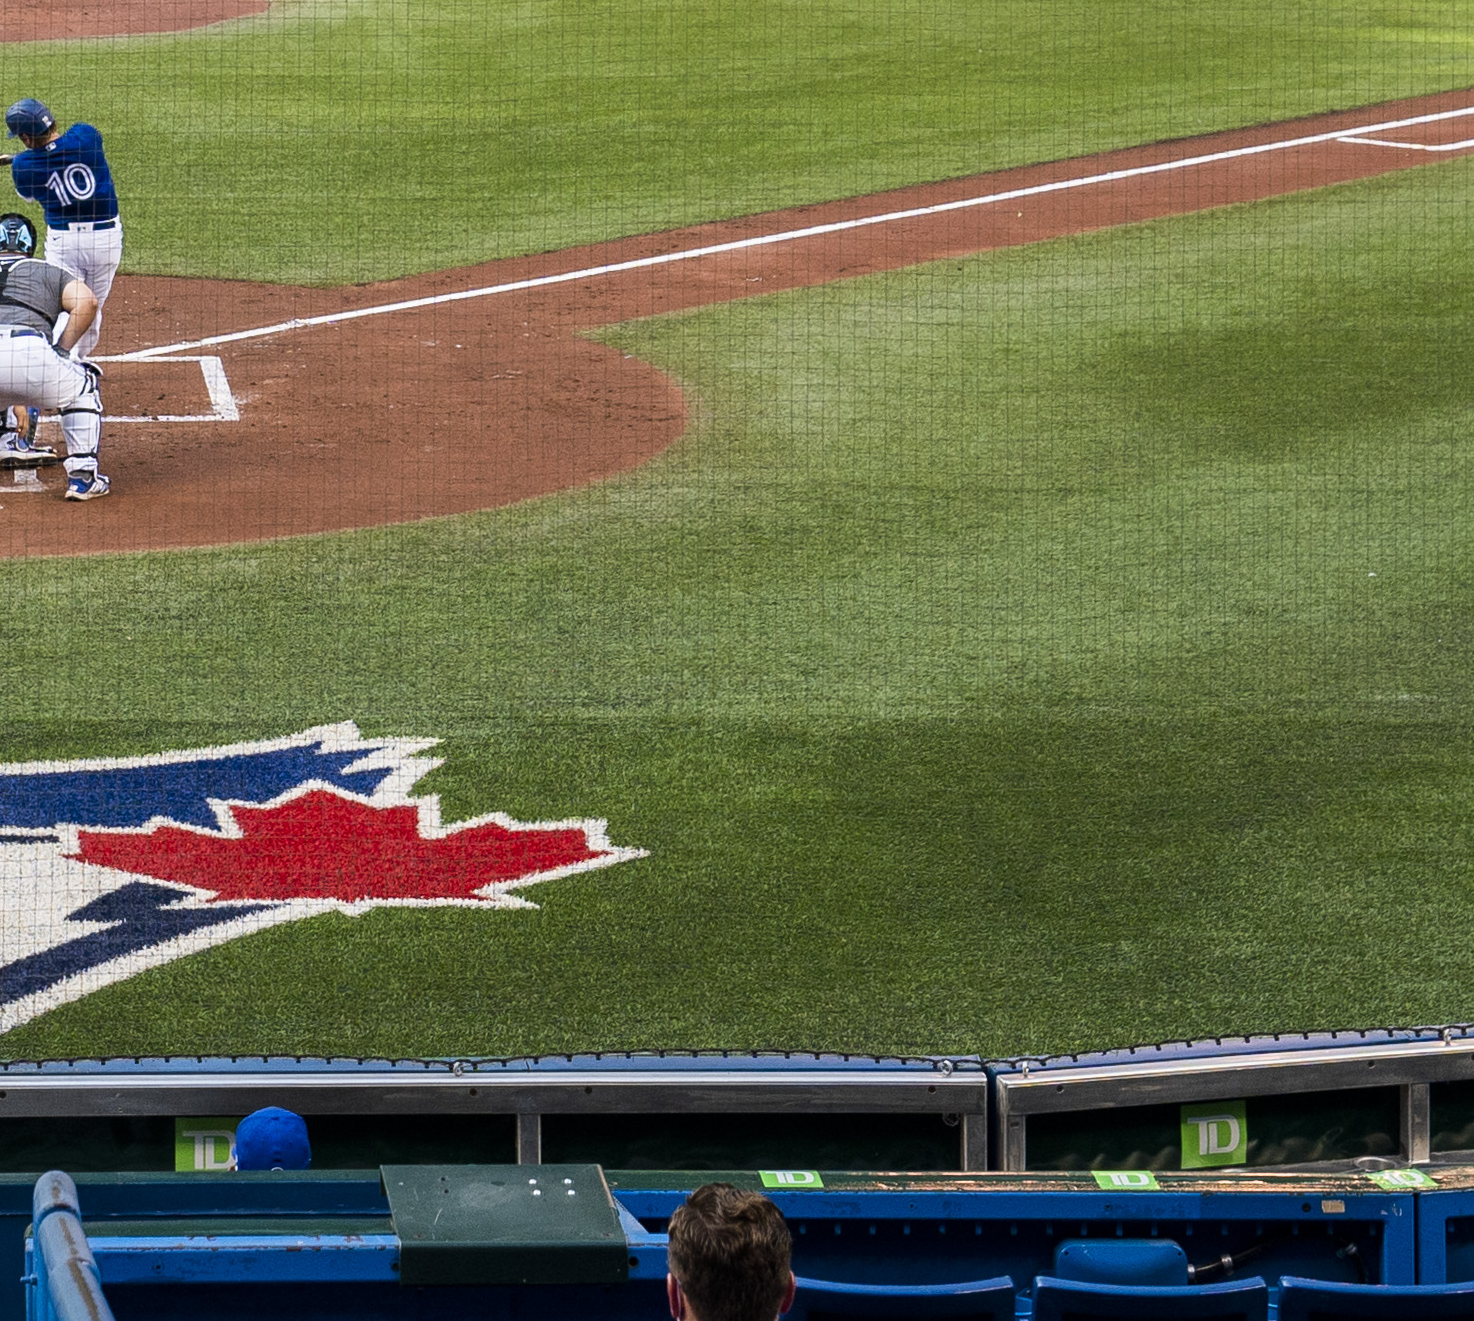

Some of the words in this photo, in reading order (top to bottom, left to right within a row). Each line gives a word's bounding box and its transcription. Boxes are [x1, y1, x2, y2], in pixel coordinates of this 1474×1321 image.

[45, 163, 96, 206] 10
[182, 1130, 236, 1169] TD
[1186, 1113, 1240, 1155] TD
[766, 1171, 815, 1185] TD
[1101, 1172, 1150, 1187] TD
